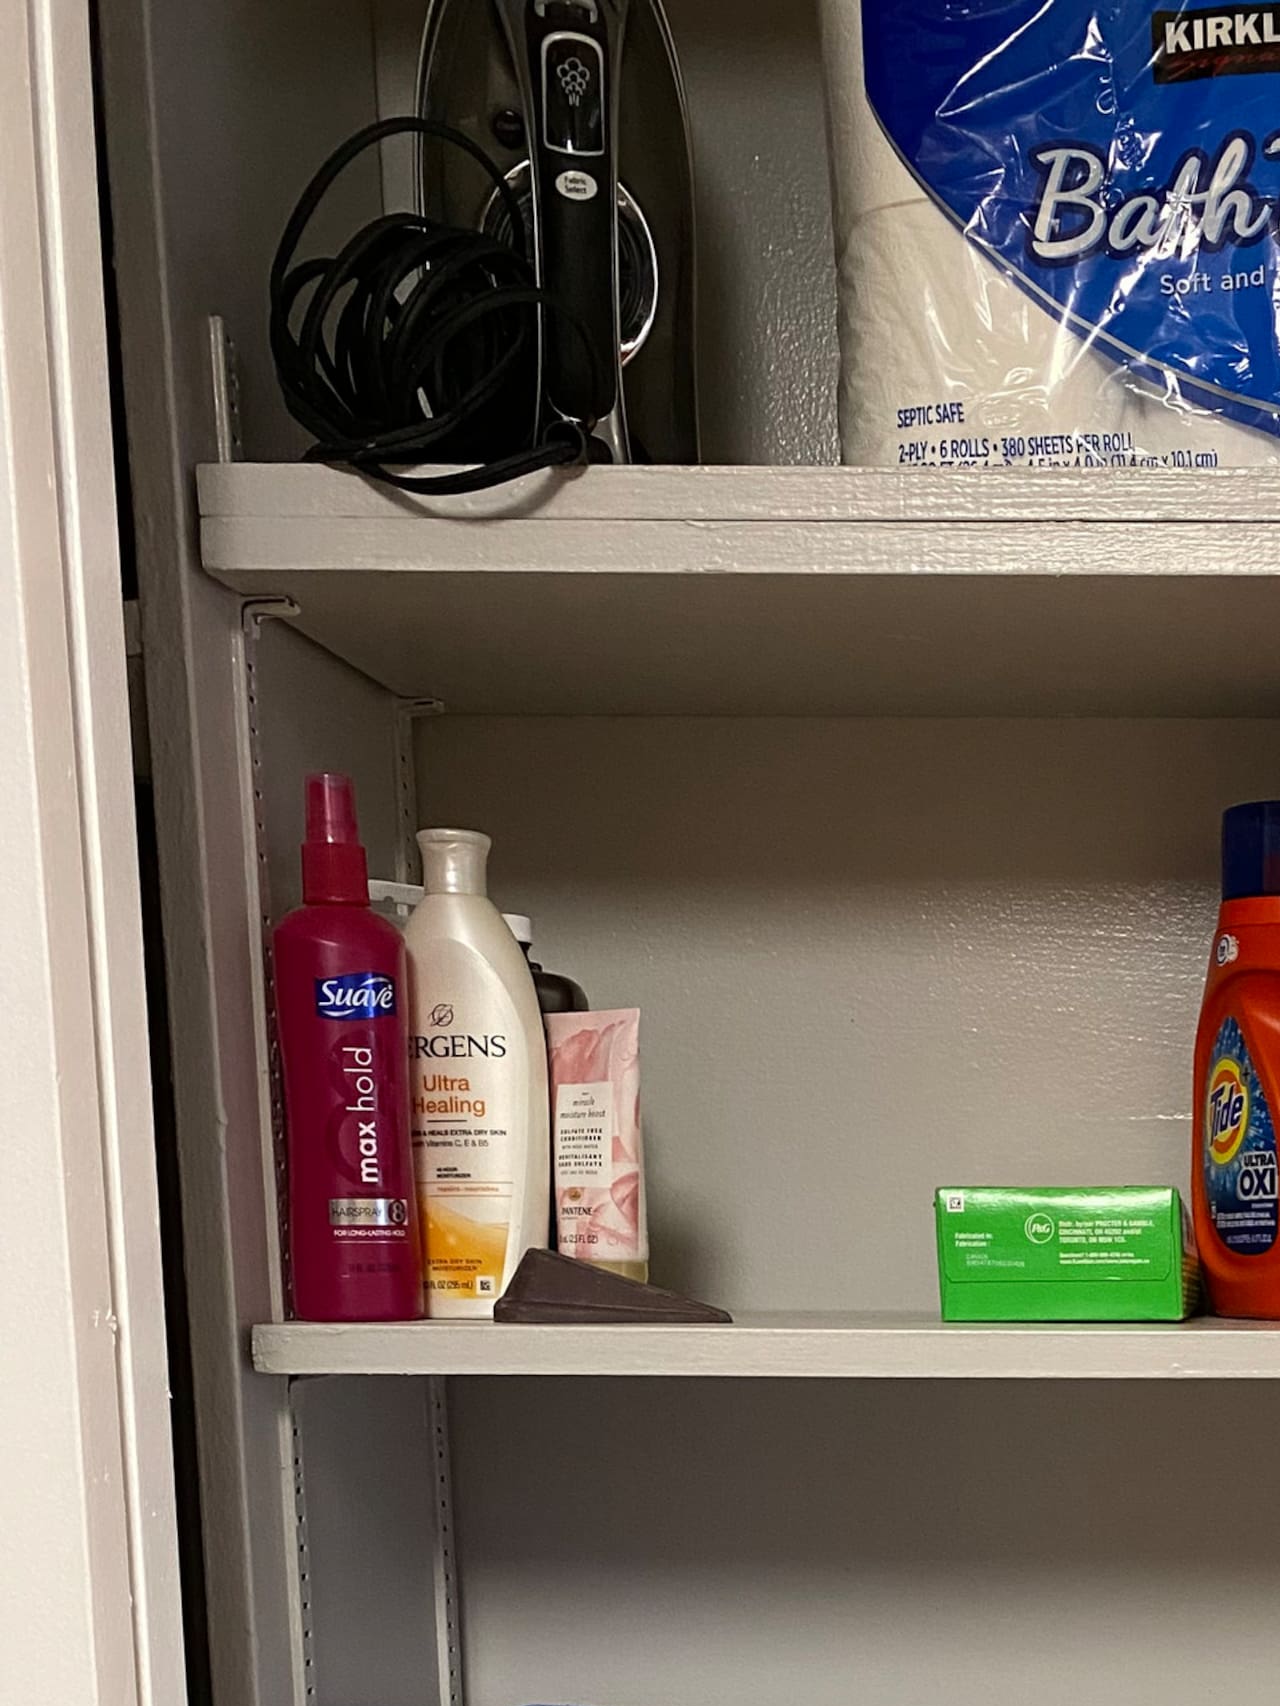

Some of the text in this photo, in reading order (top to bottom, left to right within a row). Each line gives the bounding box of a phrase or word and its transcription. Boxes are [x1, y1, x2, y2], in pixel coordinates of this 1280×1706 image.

[1032, 138, 1269, 259] Bath
[1160, 273, 1211, 294] Soft
[1221, 265, 1264, 291] and
[897, 403, 965, 428] SEPTIC SAFE
[898, 441, 928, 462] 2-PLY
[939, 440, 948, 458] 6
[951, 438, 990, 458] ROLLS
[1000, 437, 1025, 457] 380
[1028, 435, 1072, 456] SHEETS
[1076, 434, 1099, 453] PER
[318, 980, 393, 1008] Suave
[408, 1035, 506, 1059] RGENS
[423, 1075, 470, 1092] Ultra
[342, 1047, 379, 1182] max hold
[412, 1096, 486, 1118] Healing
[1209, 1080, 1245, 1148] Tide
[1243, 1152, 1275, 1167] ULTRA
[1240, 1168, 1277, 1197] OXI
[332, 1202, 404, 1223] HAIRSPRAY 8
[561, 1206, 593, 1216] PANTENE
